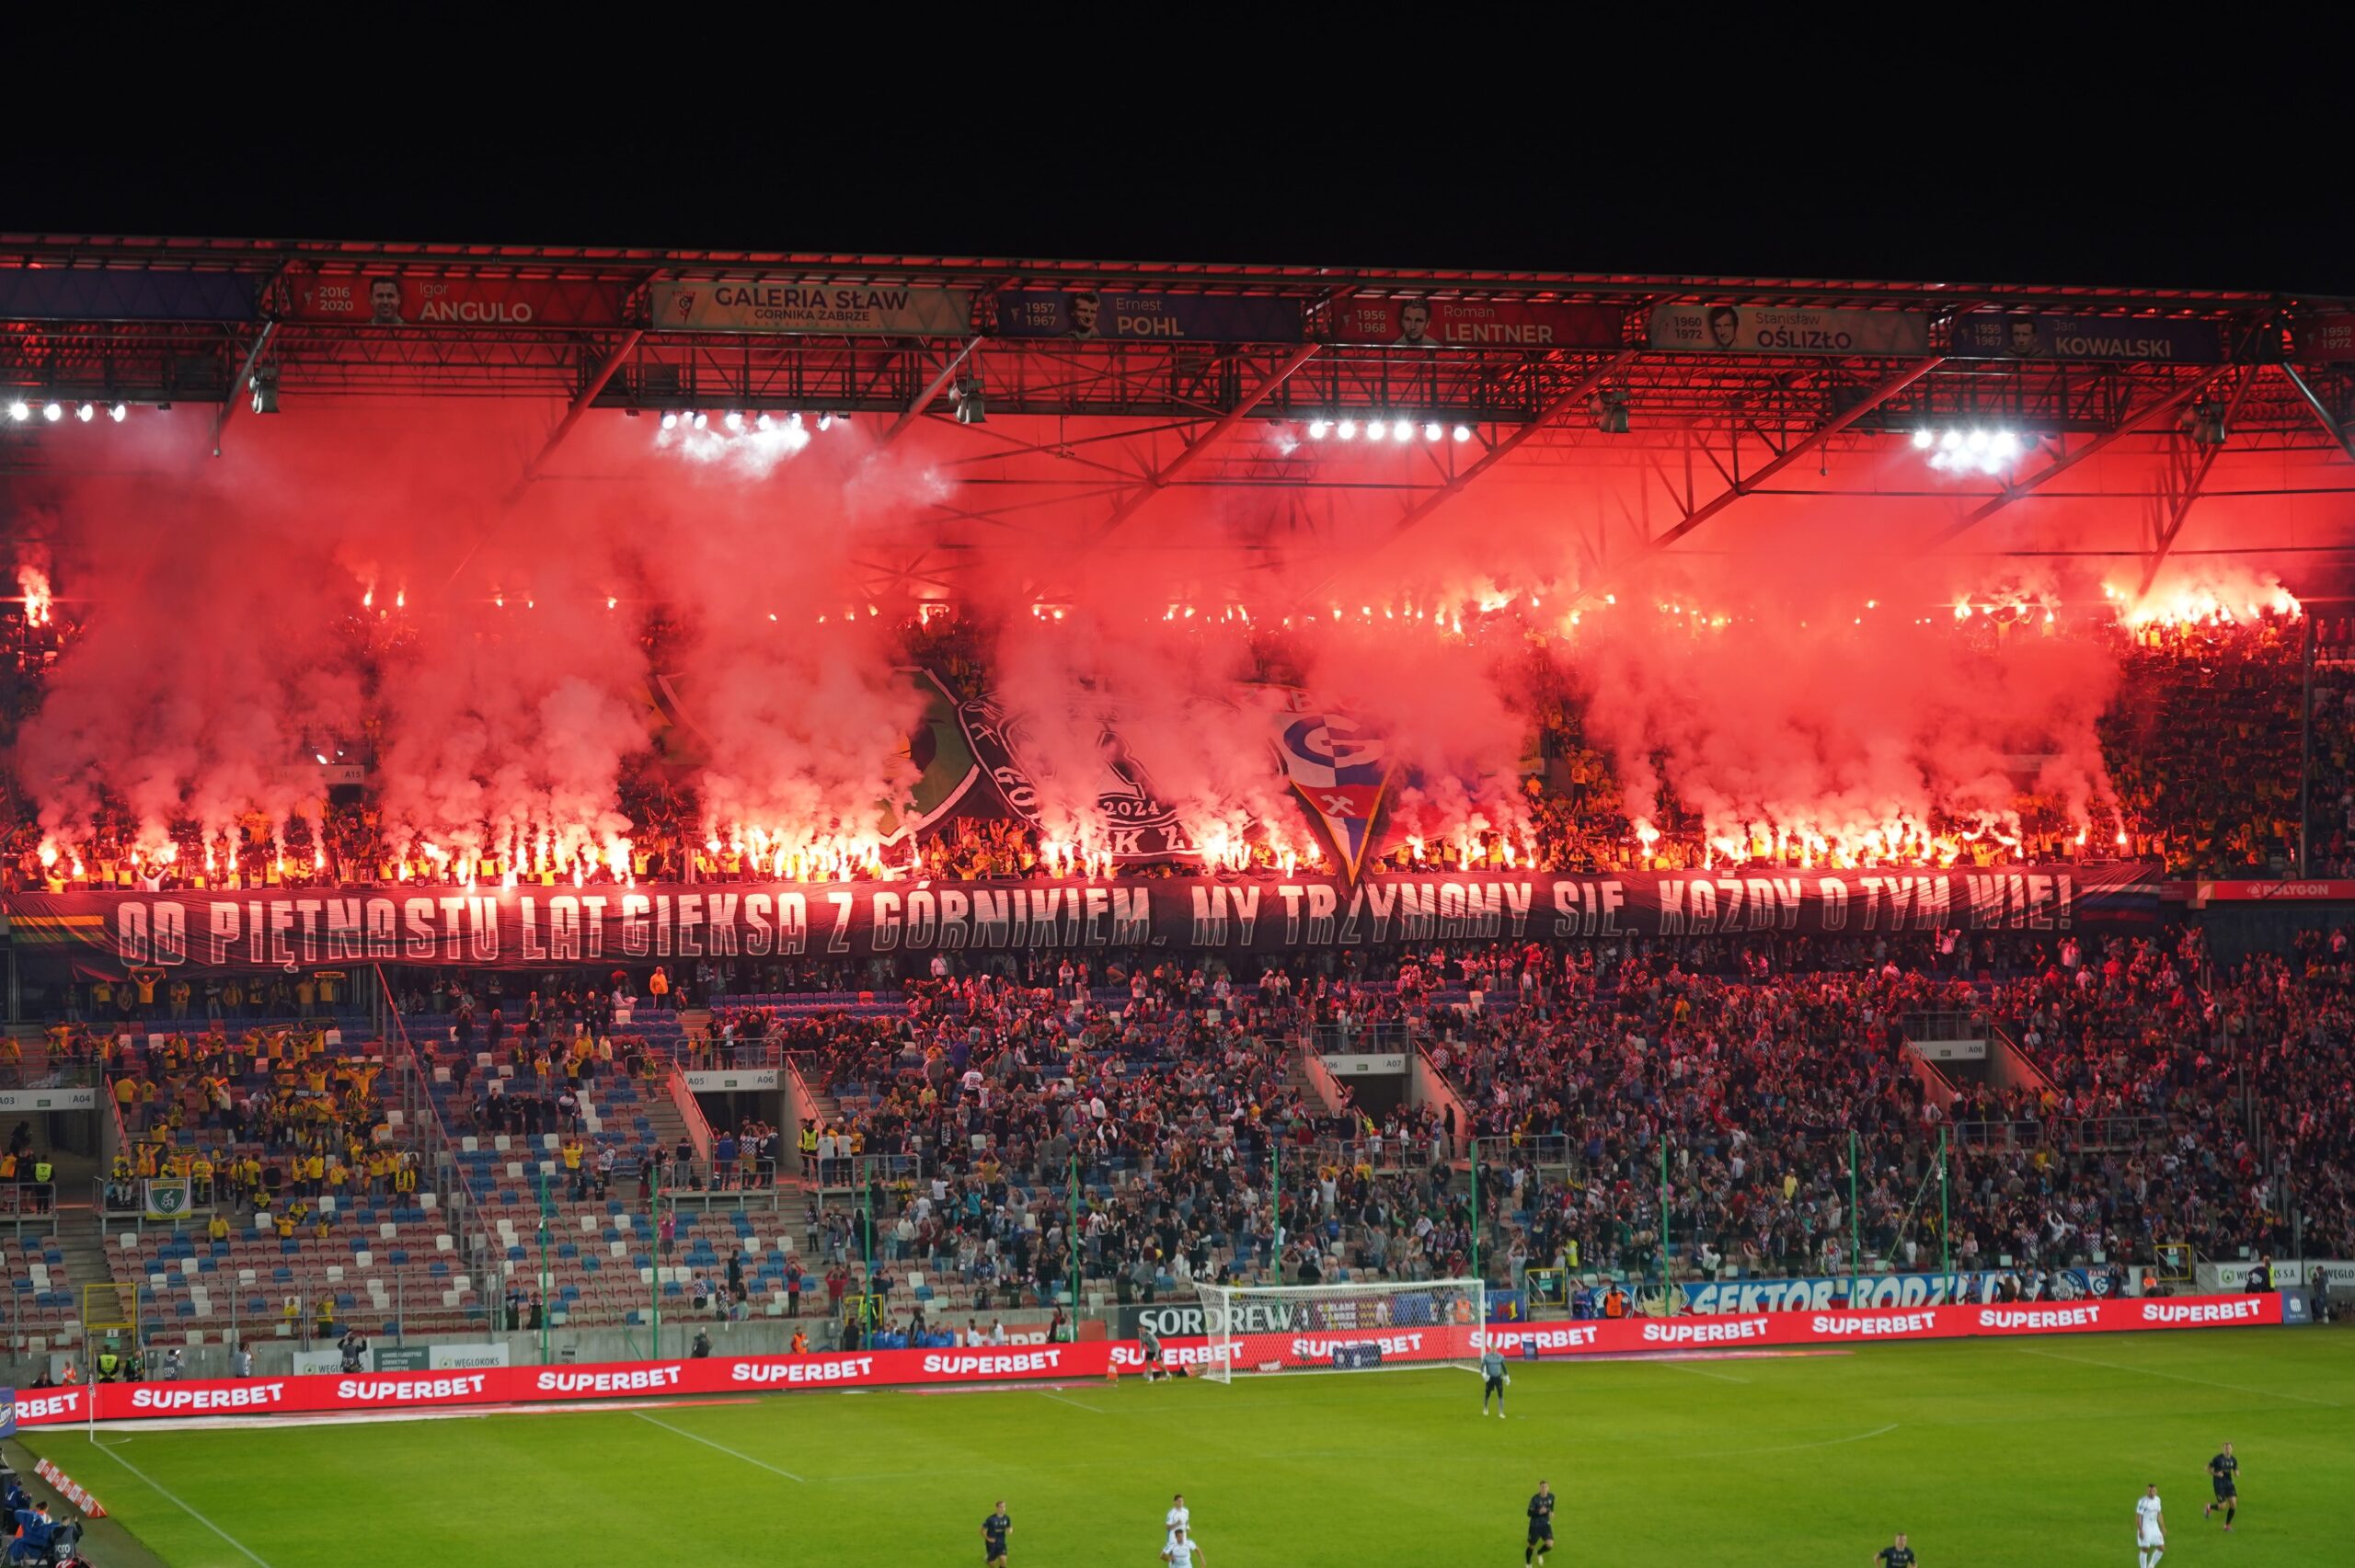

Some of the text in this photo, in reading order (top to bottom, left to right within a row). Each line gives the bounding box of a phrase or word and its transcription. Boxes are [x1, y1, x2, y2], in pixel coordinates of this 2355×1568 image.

[319, 286, 350, 299] 2016
[419, 281, 449, 298] Igor
[319, 299, 354, 312] 2020
[715, 287, 910, 311] GALERIA SŁAW
[1116, 296, 1162, 313] Ernest
[419, 302, 533, 324] ANGULO
[818, 309, 870, 322] ZABRZE
[1026, 302, 1055, 315] 1957
[1356, 308, 1386, 322] 1956
[1443, 304, 1496, 318] Roman
[1026, 314, 1057, 327] 1967
[1117, 315, 1185, 338] POHL
[1673, 316, 1702, 329] 1960
[1754, 311, 1821, 327] Stanisław
[2053, 319, 2077, 333] Jan
[1357, 321, 1387, 334] 1968
[1444, 322, 1554, 344] LENTNER
[1674, 327, 1703, 340] 1972
[1974, 323, 2002, 335] 1959
[2321, 326, 2352, 338] 1959
[1756, 325, 1853, 350] OŚLIZŁO
[1975, 335, 2003, 347] 1967
[2321, 338, 2352, 349] 1972
[2055, 337, 2172, 359] KOWALSKI
[1103, 800, 1161, 817] 2024
[2263, 884, 2329, 896] POLYGON
[118, 901, 185, 967] OD
[210, 896, 499, 973] PIĘTNASTU
[521, 895, 607, 960] LAT
[622, 892, 807, 957] GIEKSA
[827, 891, 854, 954] Z
[1191, 885, 1260, 946] MY
[1278, 882, 1533, 944] TRZYMAMY
[1658, 870, 1801, 935] KAŻDY
[1819, 876, 1848, 931] O
[1859, 875, 1950, 931] TYM
[1966, 874, 2071, 931] WIE!
[1386, 1059, 1402, 1068] A07
[688, 1077, 705, 1085] A05
[757, 1075, 774, 1083] A06
[73, 1094, 90, 1103] A04
[1692, 1280, 1836, 1315] SEKTOR
[1979, 1305, 2100, 1330] SUPERBET
[2142, 1299, 2261, 1322] SUPERBET
[1642, 1317, 1769, 1343] SUPERBET
[1811, 1311, 1936, 1336] SUPERBET
[923, 1349, 1061, 1374] SUPERBET
[1109, 1341, 1244, 1367] SUERBET
[454, 1356, 500, 1369] WĘGLOKOKS
[731, 1356, 873, 1383] SUPERBET
[536, 1366, 682, 1392] SUPERBET
[337, 1374, 486, 1401] SUPERBET
[131, 1382, 284, 1410] SUPERBET
